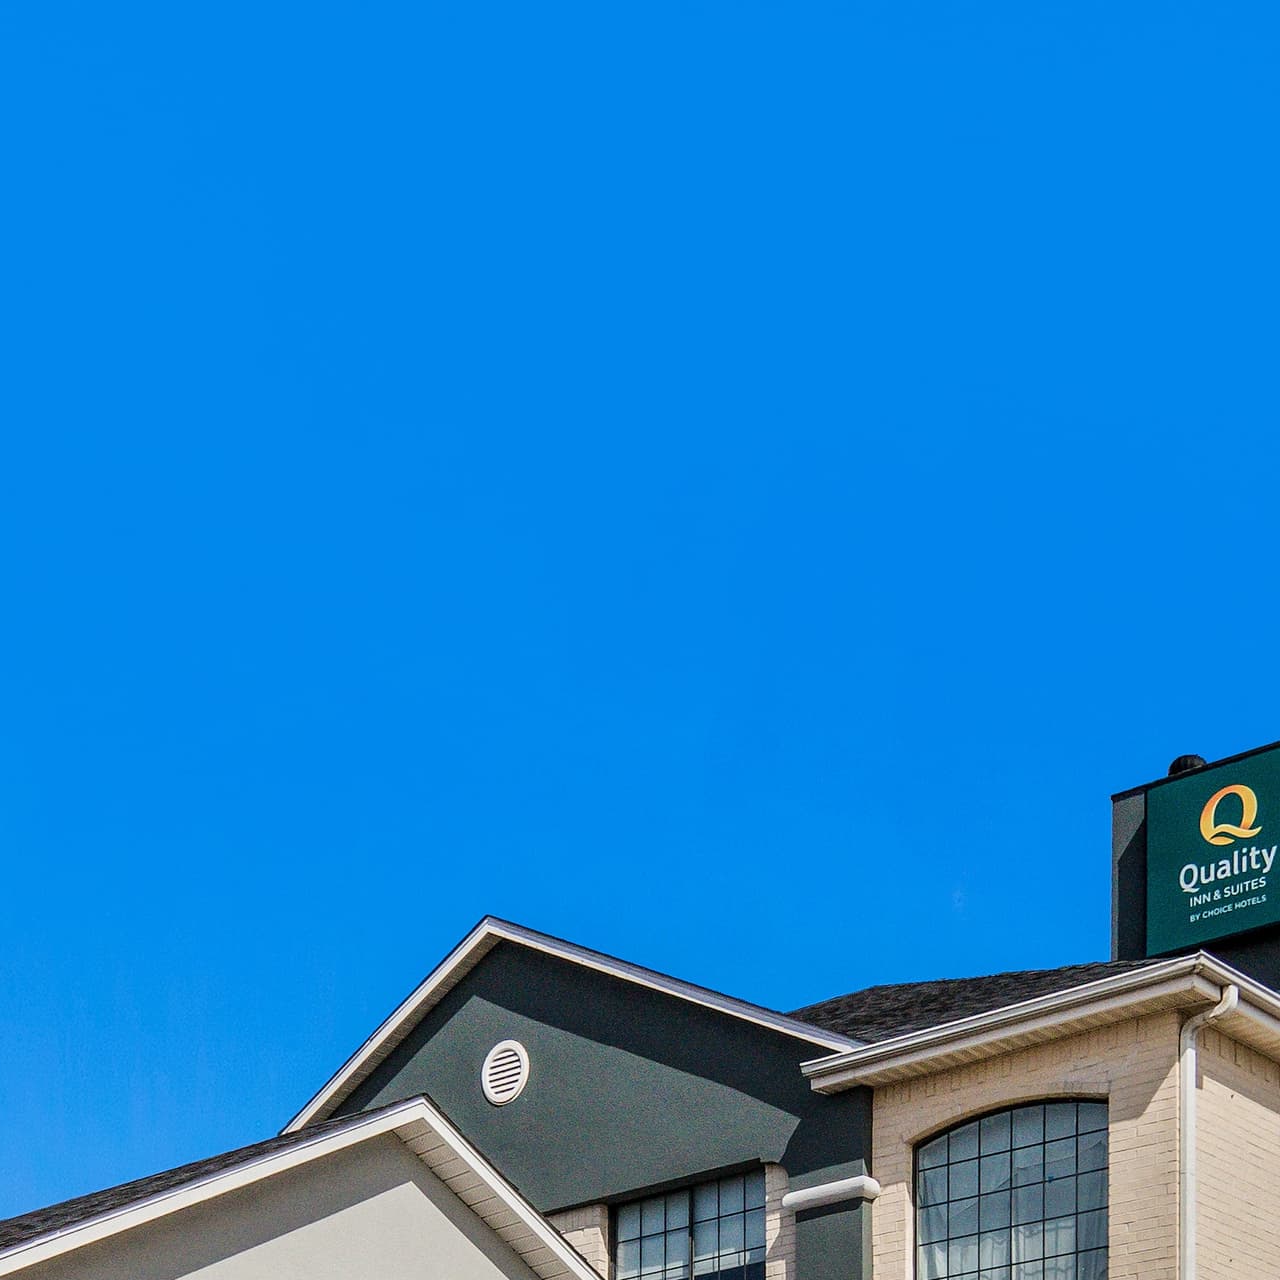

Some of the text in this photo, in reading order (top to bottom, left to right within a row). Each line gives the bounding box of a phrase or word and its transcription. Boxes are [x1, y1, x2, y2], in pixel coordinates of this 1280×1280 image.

[1200, 784, 1263, 846] Q
[1179, 845, 1278, 893] Quality
[1189, 876, 1267, 907] INN & SUITES
[1189, 894, 1267, 922] BY CHOICE HOTELS
